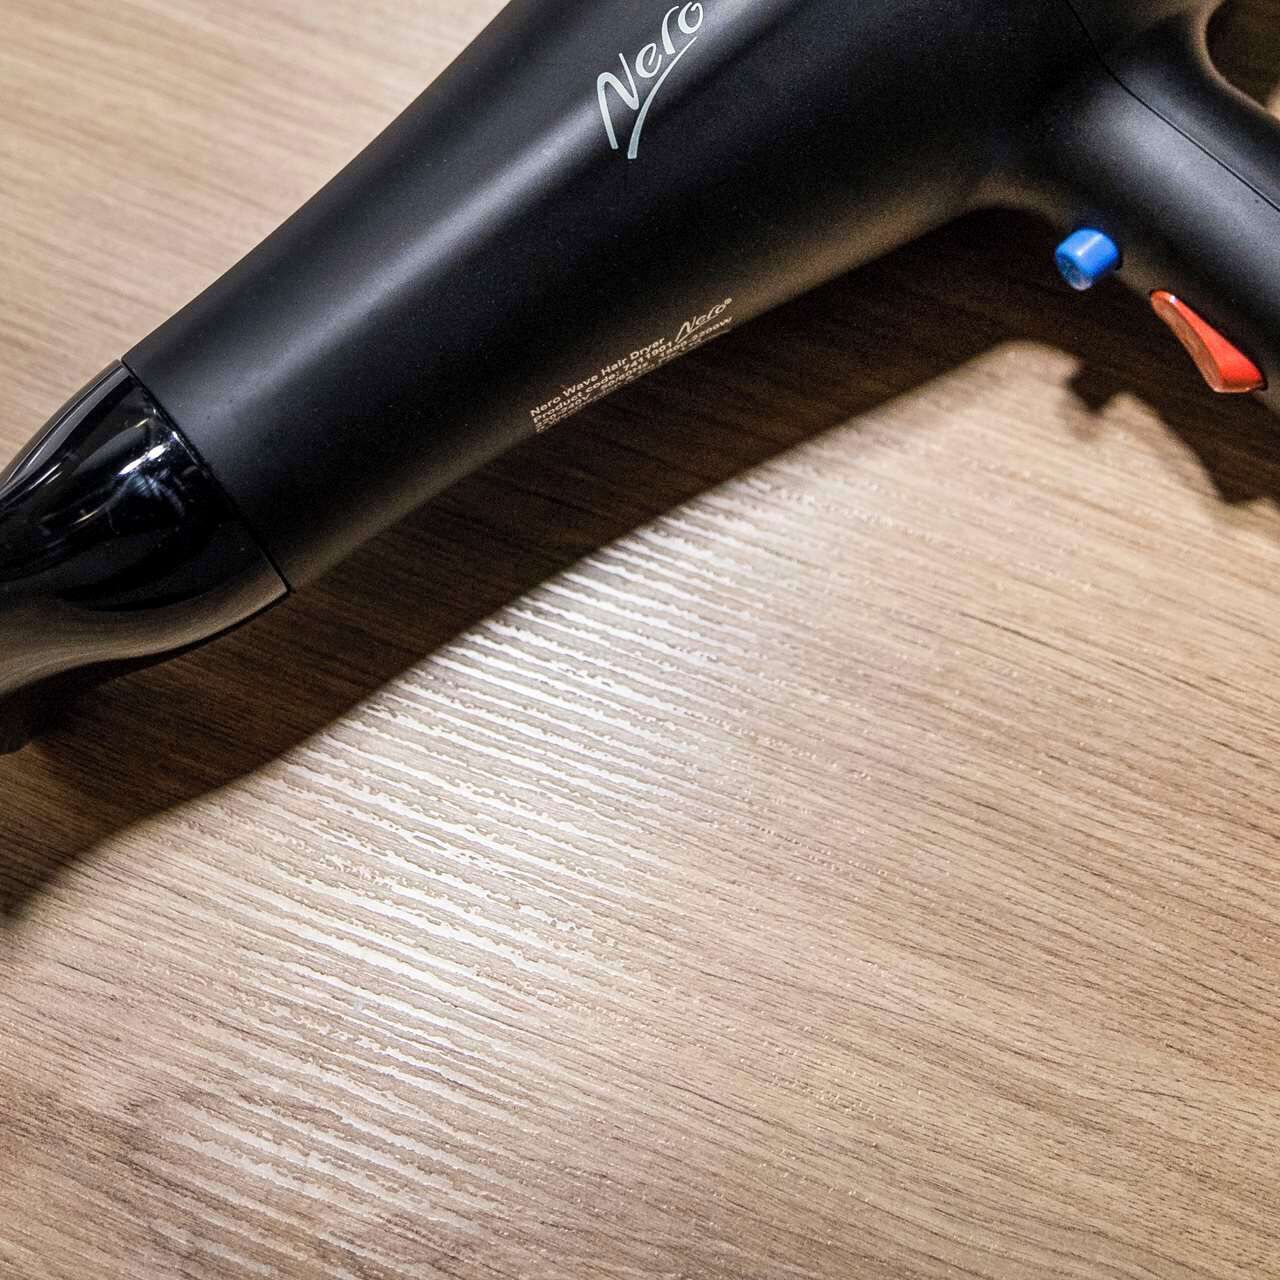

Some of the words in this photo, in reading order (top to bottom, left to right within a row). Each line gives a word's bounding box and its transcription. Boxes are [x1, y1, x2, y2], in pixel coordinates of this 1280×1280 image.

[530, 396, 561, 417] Nero
[562, 375, 598, 398] Wave
[601, 358, 628, 377] Hair
[630, 337, 665, 362] Dryer
[533, 391, 583, 424] Product
